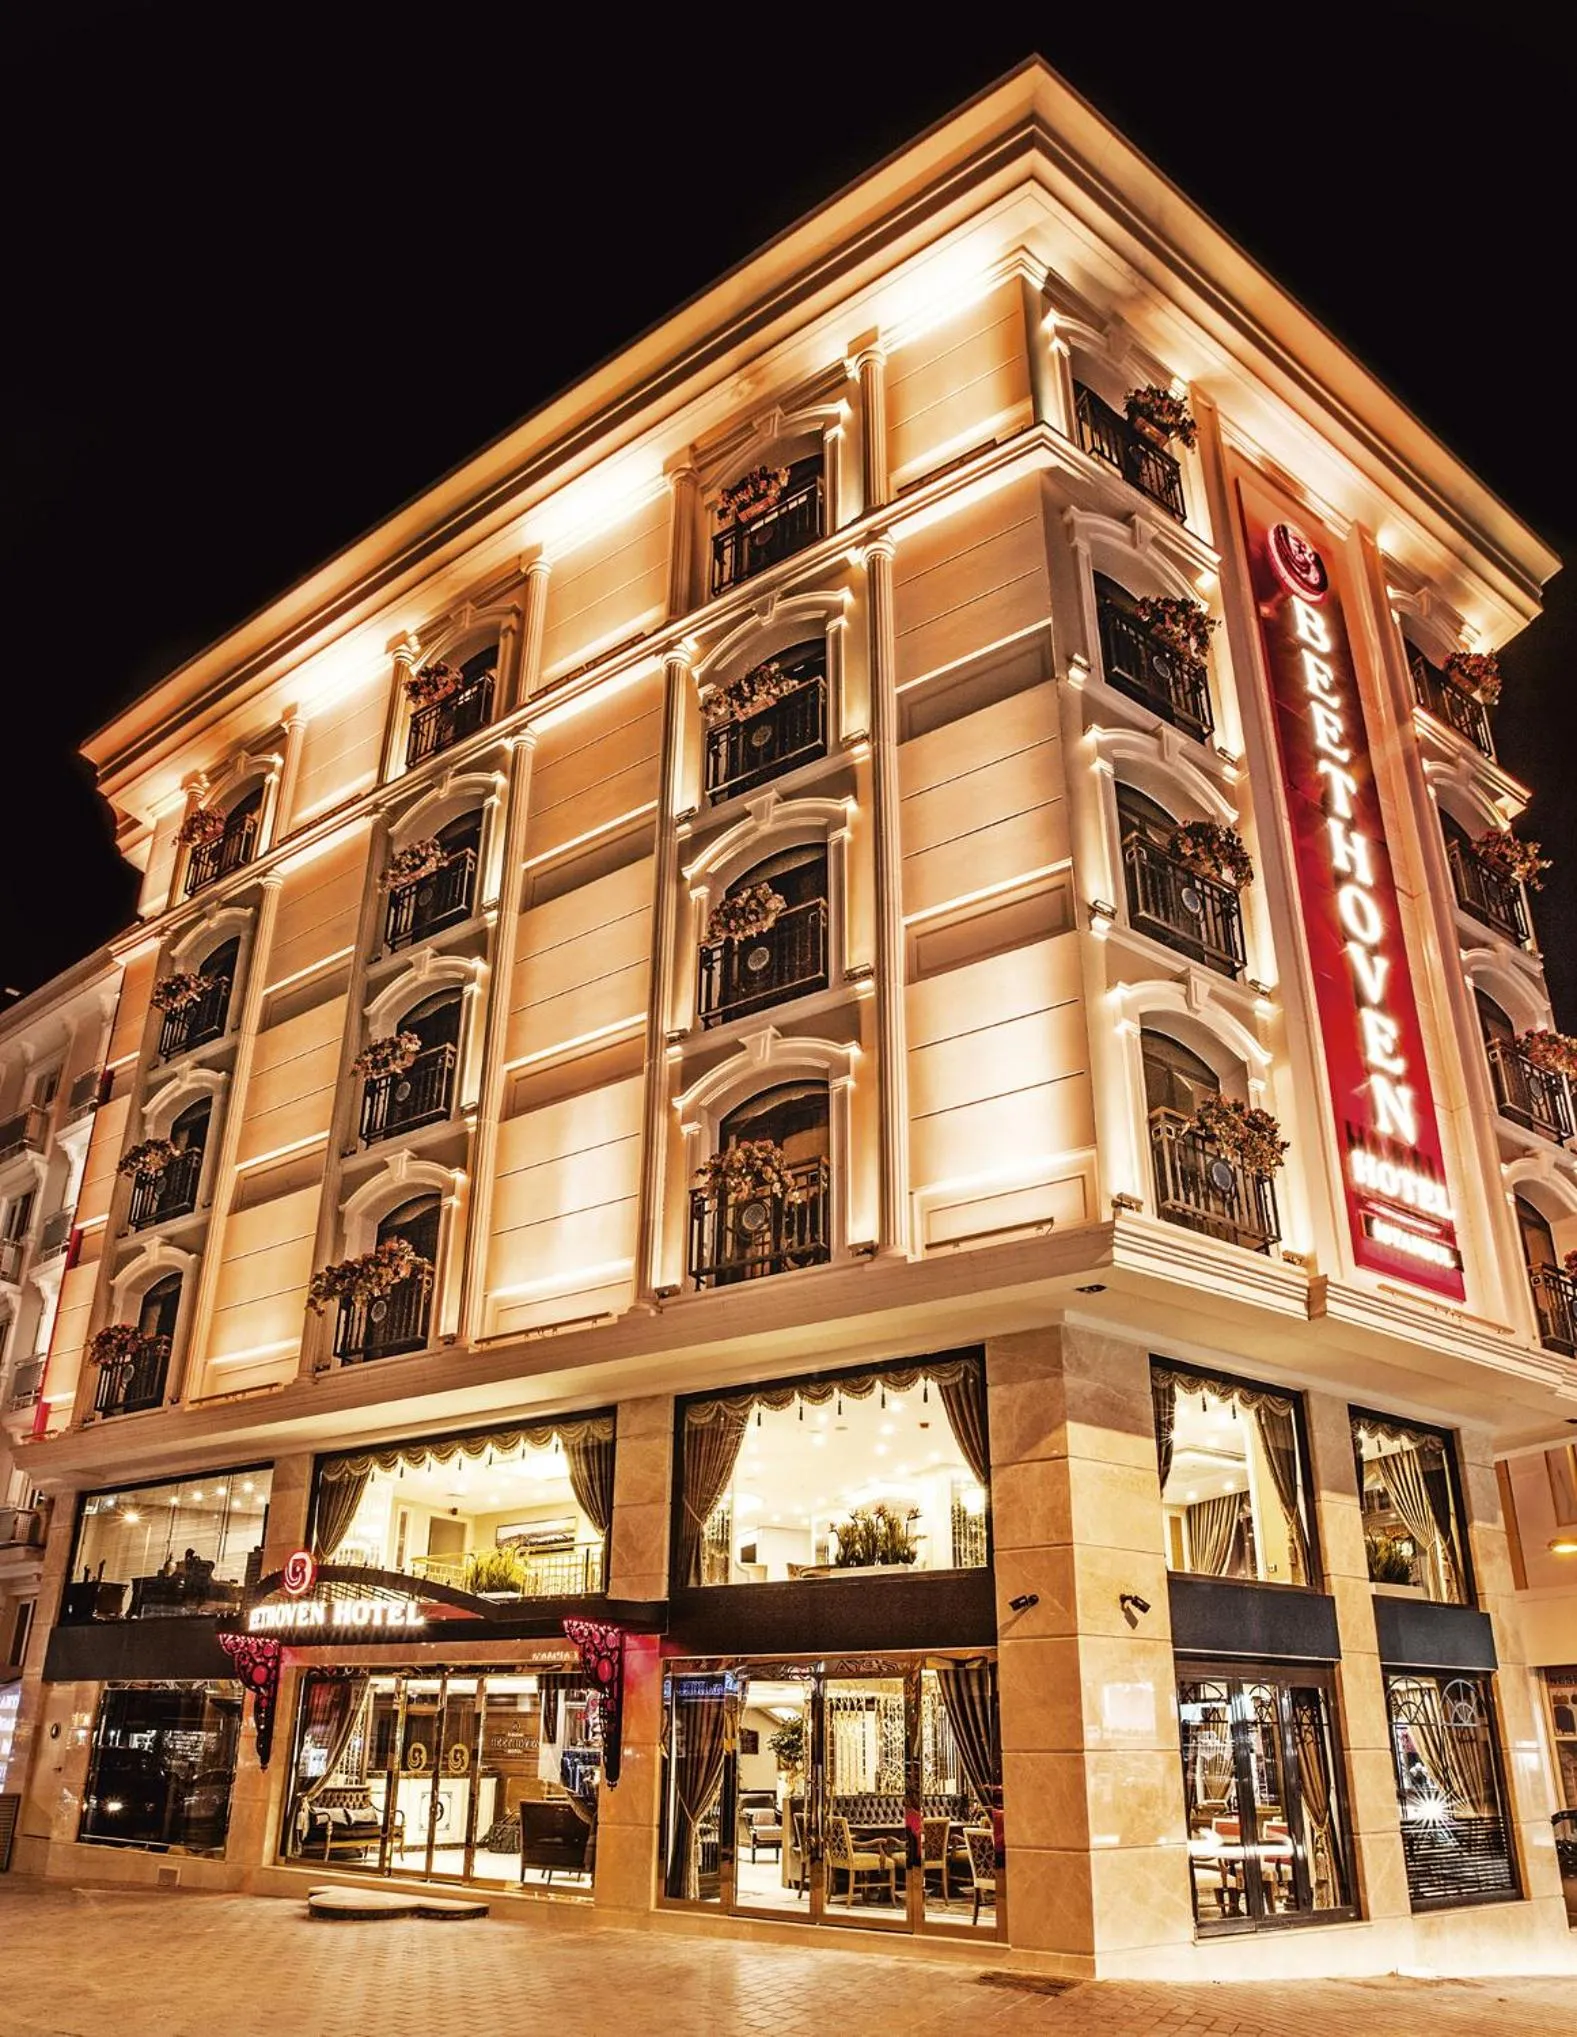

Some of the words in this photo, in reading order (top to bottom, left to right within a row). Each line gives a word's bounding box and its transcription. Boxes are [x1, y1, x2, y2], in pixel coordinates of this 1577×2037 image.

[1291, 595, 1417, 1146] BEETHOVEN
[1350, 1148, 1456, 1220] HOTEL
[332, 1600, 425, 1626] HOTEL
